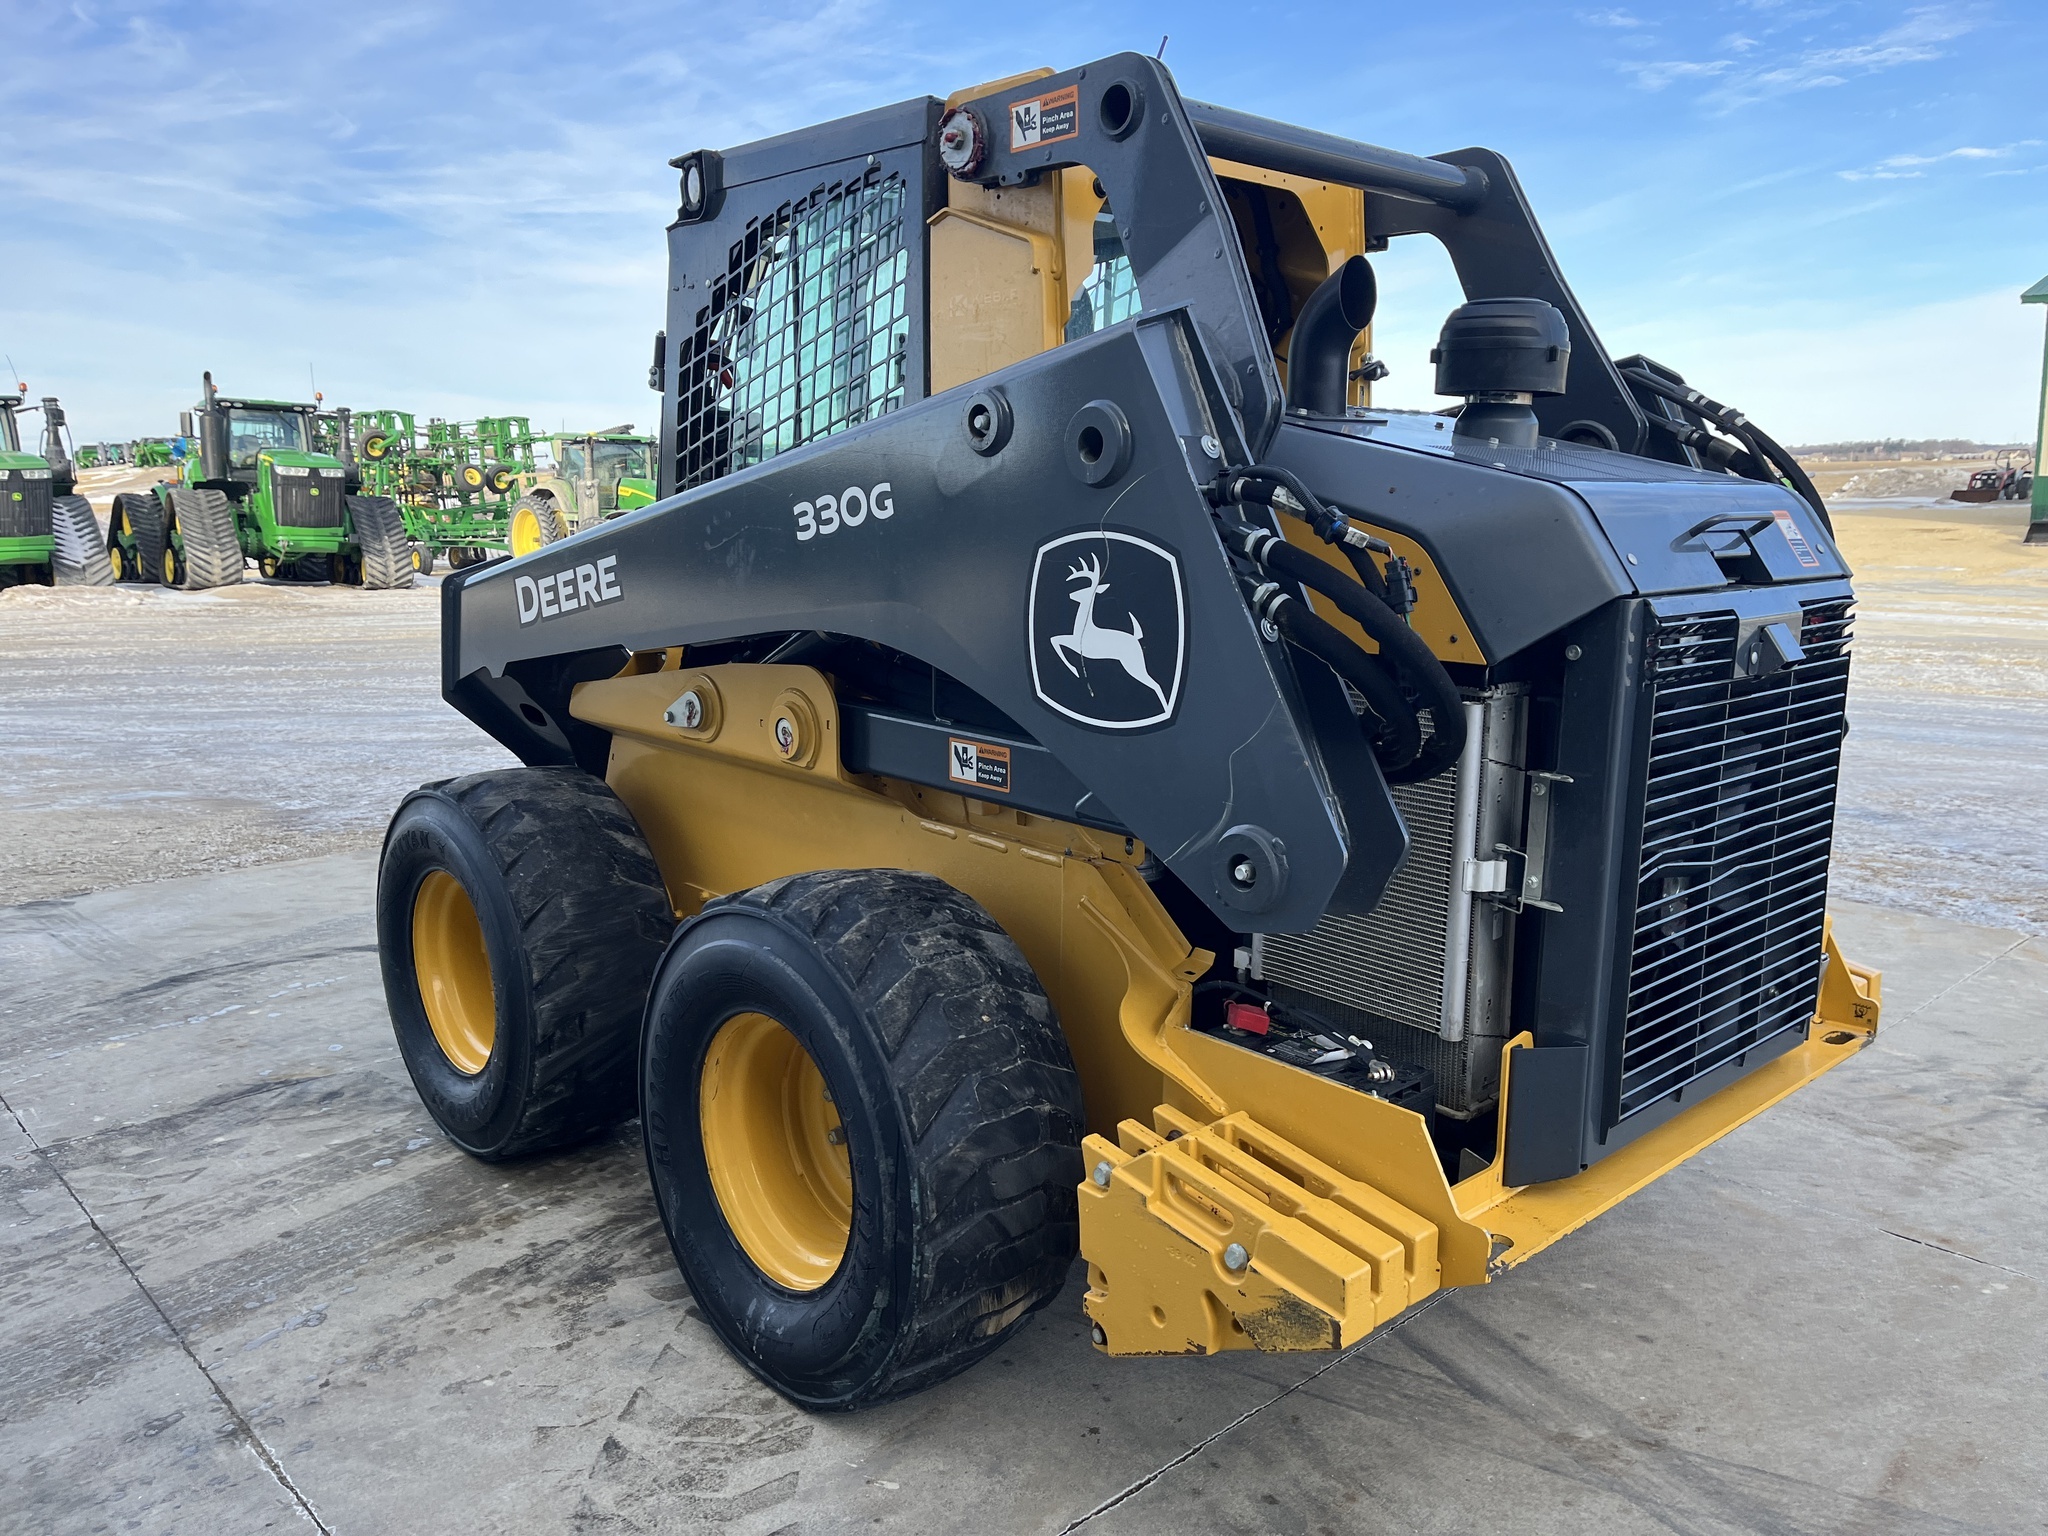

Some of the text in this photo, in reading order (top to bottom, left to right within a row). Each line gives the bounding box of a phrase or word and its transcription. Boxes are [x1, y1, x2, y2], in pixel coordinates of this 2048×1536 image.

[1049, 91, 1074, 103] WARNING
[1042, 110, 1074, 124] Pinch Area
[1042, 122, 1070, 134] Keep Away
[793, 482, 894, 541] 330G
[514, 554, 622, 625] DEERE
[984, 749, 1007, 758] WARNING
[978, 762, 1006, 774] Pinch Area
[978, 772, 1002, 783] Keep Away
